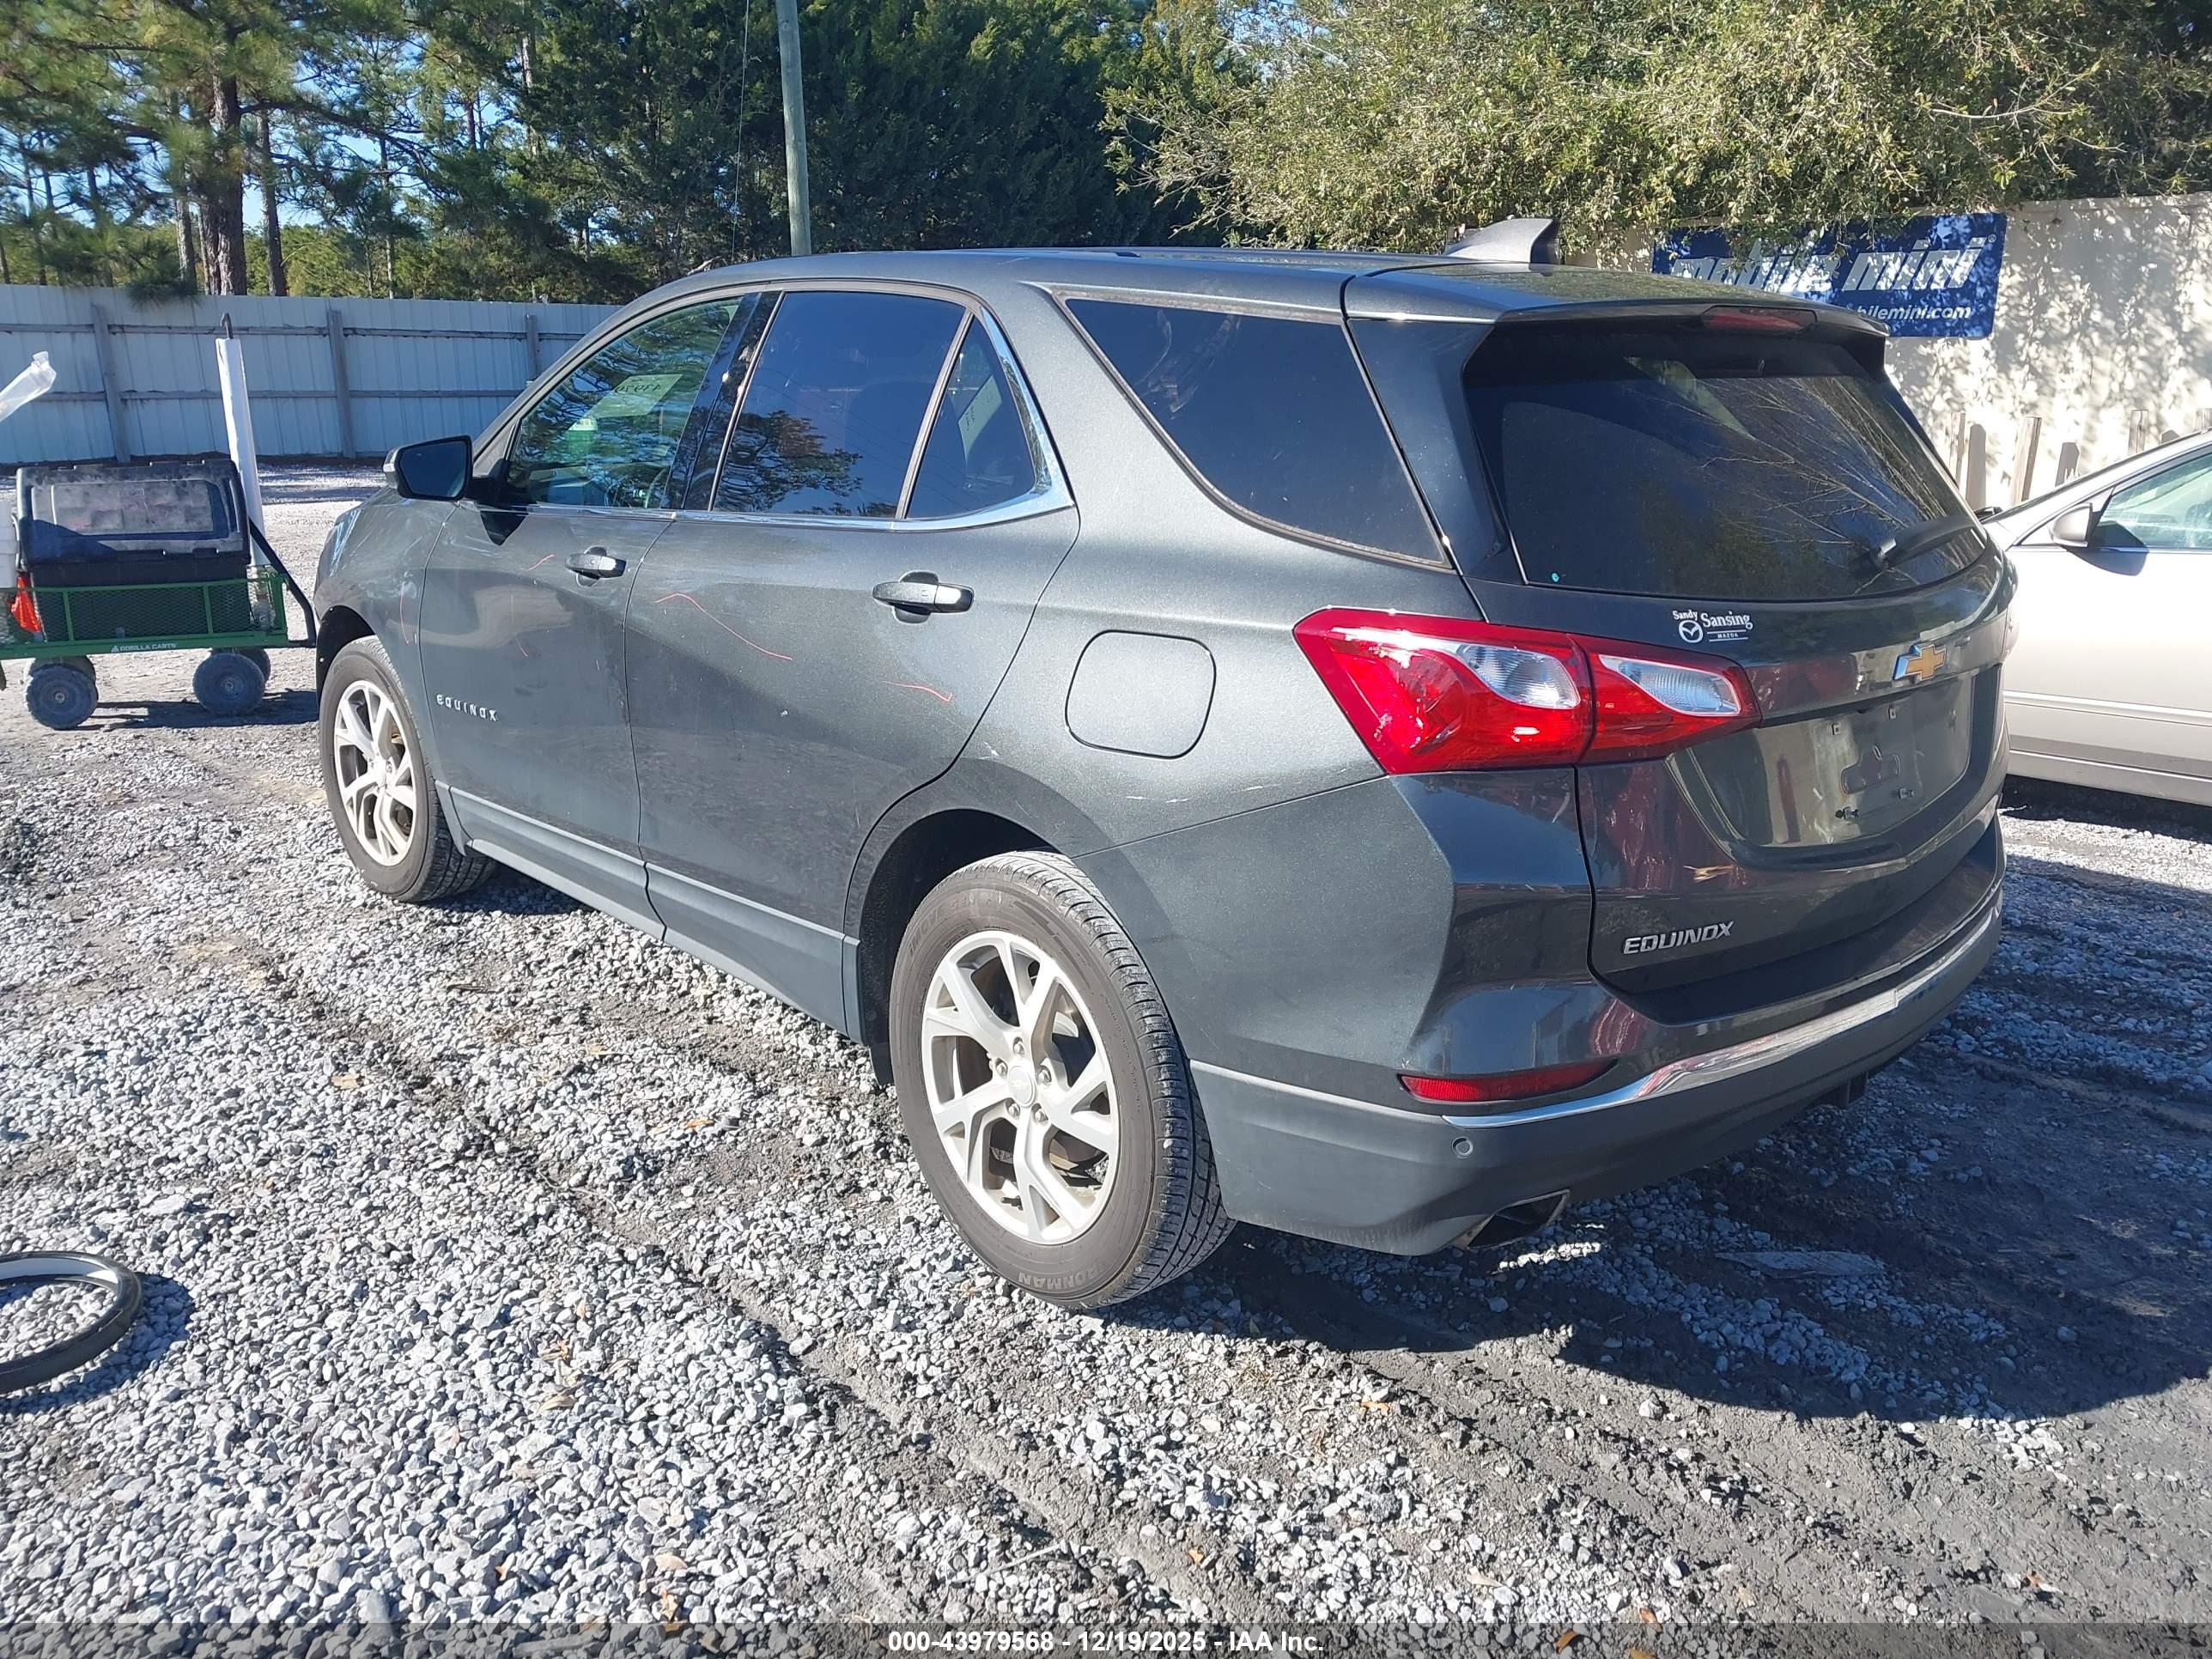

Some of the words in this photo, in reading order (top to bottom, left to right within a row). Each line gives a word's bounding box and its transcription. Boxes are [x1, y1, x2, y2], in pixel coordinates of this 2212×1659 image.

[1672, 609, 1698, 621] Sandy
[1700, 611, 1753, 630] Sansing
[436, 694, 498, 722] EQUINOX
[1623, 921, 1735, 955] EQUINOX
